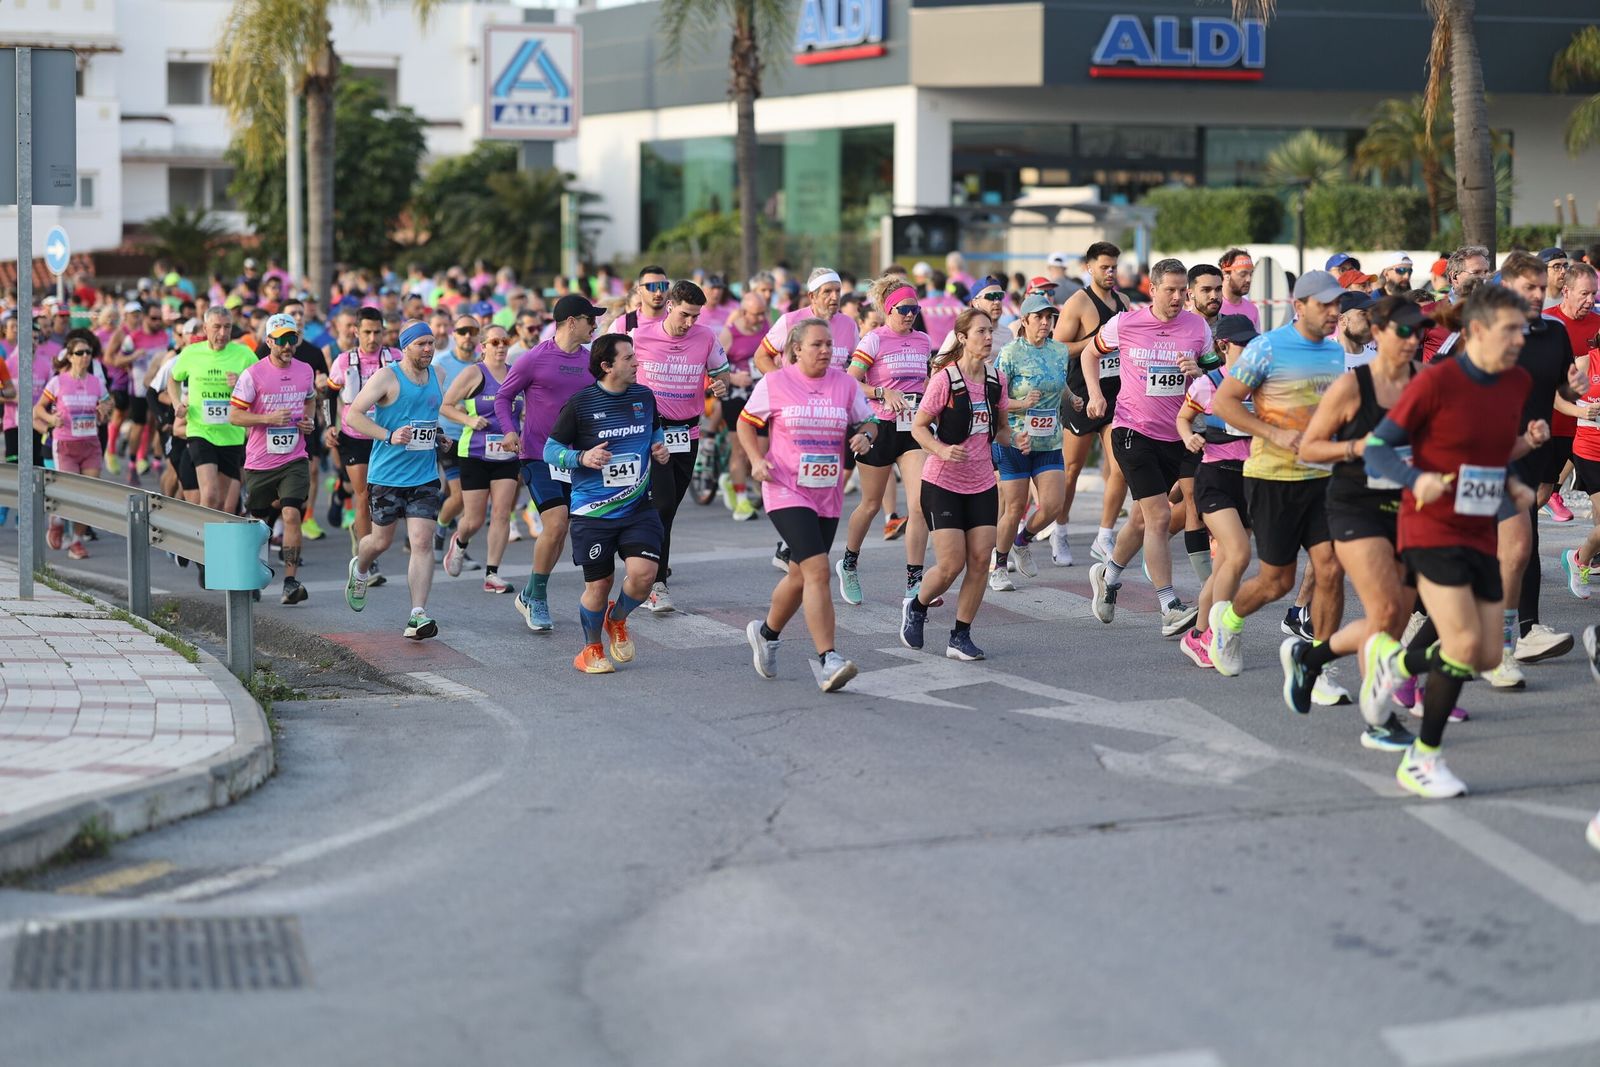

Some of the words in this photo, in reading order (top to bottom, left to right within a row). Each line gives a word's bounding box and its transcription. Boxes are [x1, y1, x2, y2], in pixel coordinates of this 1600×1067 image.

[794, 0, 882, 51] ALDI
[1092, 14, 1266, 68] ALDI
[500, 104, 564, 123] ALDI
[665, 354, 688, 363] XXXVI
[1129, 348, 1155, 359] MEDIA
[643, 362, 667, 374] MEDIA
[1101, 357, 1120, 369] 129
[1150, 374, 1185, 386] 1489
[201, 391, 231, 399] GLENN
[207, 407, 228, 416] 551
[782, 406, 811, 418] MEDIA
[1030, 417, 1053, 428] 622
[598, 425, 645, 438] enerplus
[272, 435, 294, 445] 637
[666, 432, 689, 444] 313
[609, 462, 635, 477] 541
[803, 463, 838, 477] 1263
